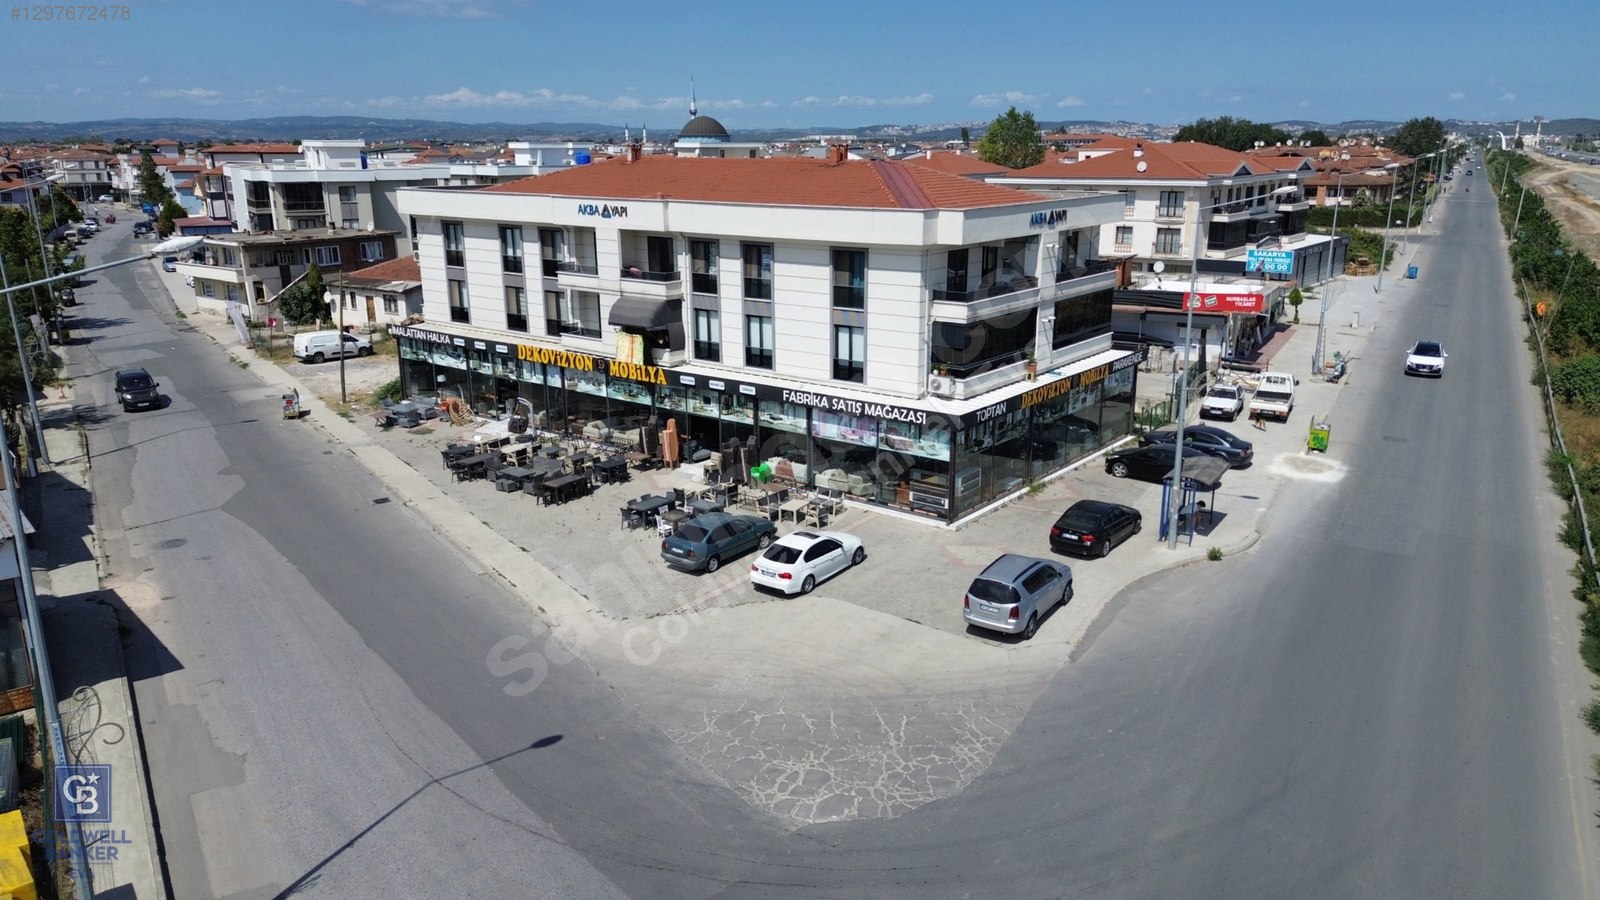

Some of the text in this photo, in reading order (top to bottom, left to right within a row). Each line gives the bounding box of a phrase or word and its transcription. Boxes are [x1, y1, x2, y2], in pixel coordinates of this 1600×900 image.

[577, 204, 628, 218] AKBA YAPI
[1029, 212, 1047, 225] AKBA
[427, 332, 451, 345] HALKA
[832, 398, 861, 416] SATIŞ
[865, 404, 926, 424] MAĞAZASI
[976, 402, 1007, 423] TOPTAN
